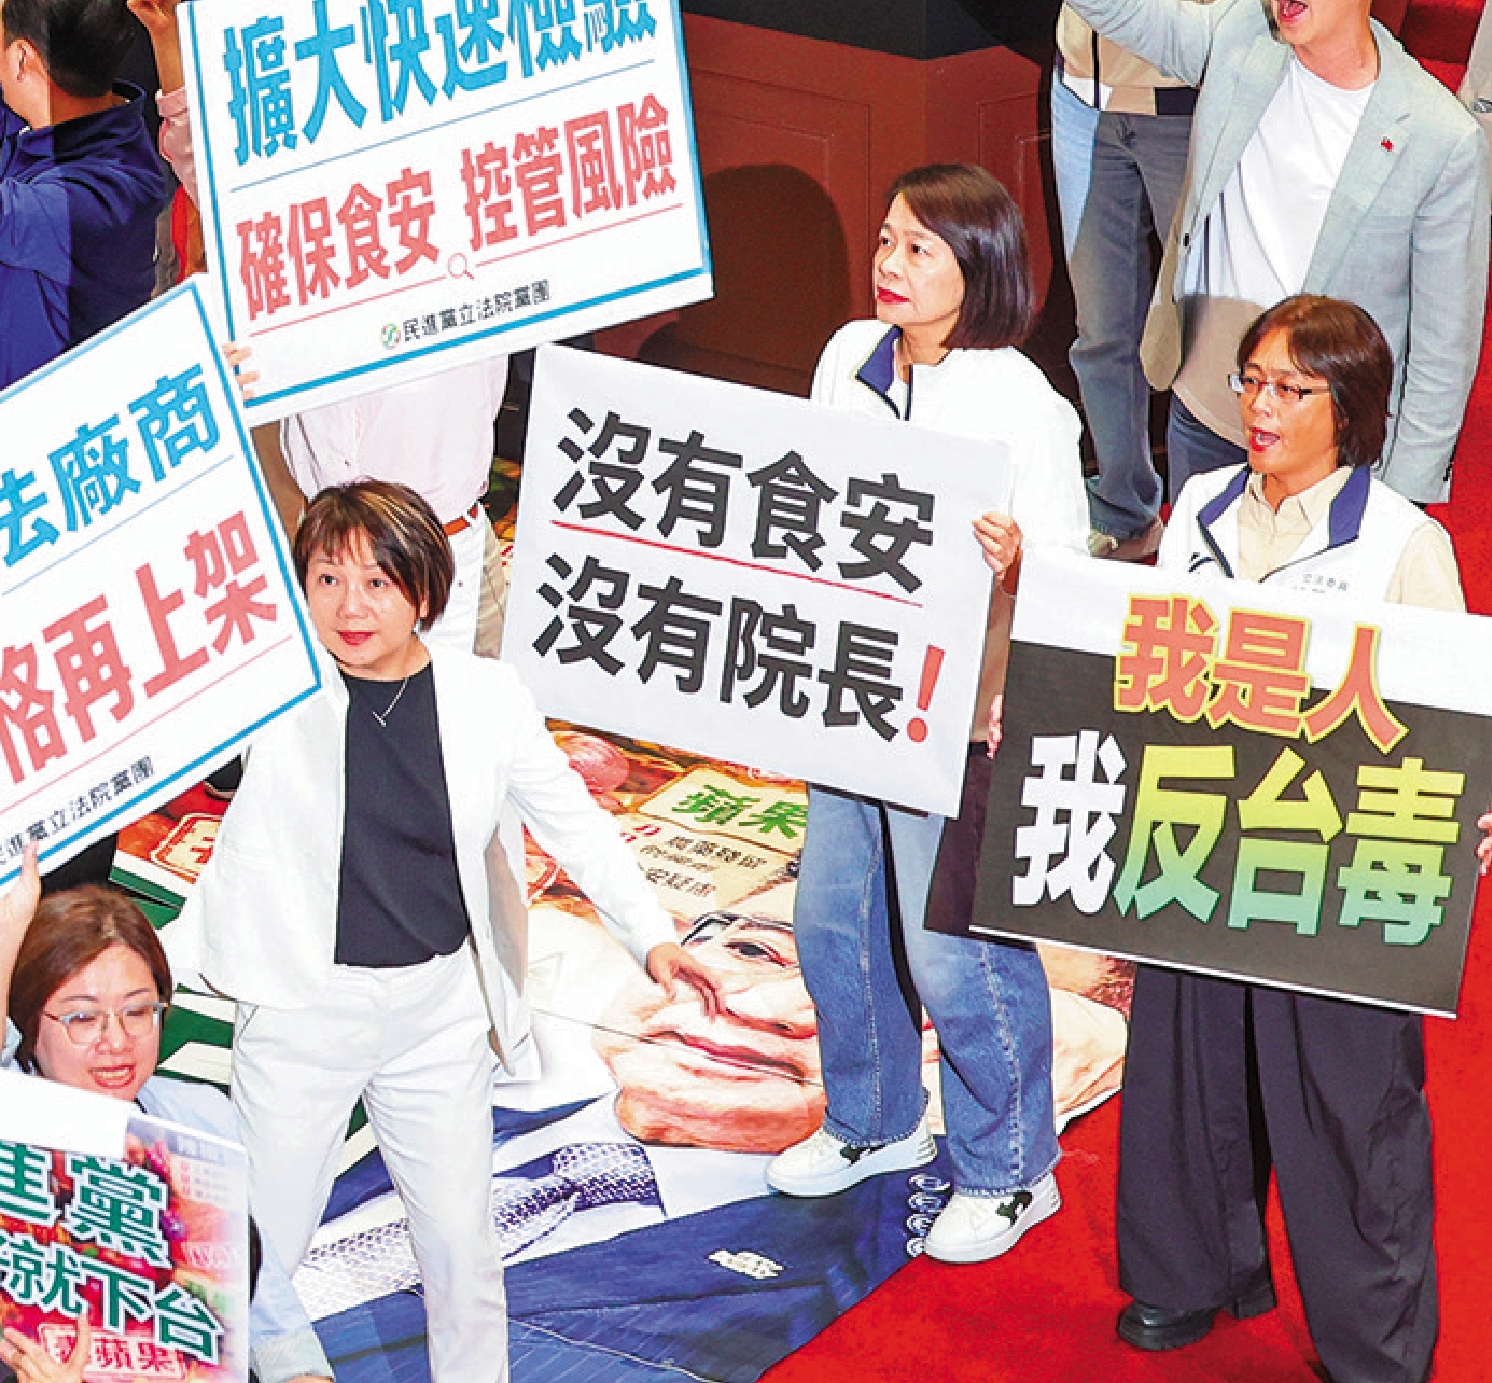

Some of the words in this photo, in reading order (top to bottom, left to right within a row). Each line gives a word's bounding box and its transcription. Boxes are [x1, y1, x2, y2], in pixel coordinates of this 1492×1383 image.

[236, 168, 441, 320] 確保食安
[460, 93, 678, 252] 控管風險
[553, 408, 936, 595] 沒有食安
[531, 554, 945, 744] 沒有院長!
[1113, 592, 1408, 755] 我是人
[1013, 731, 1465, 945] 我反台毒
